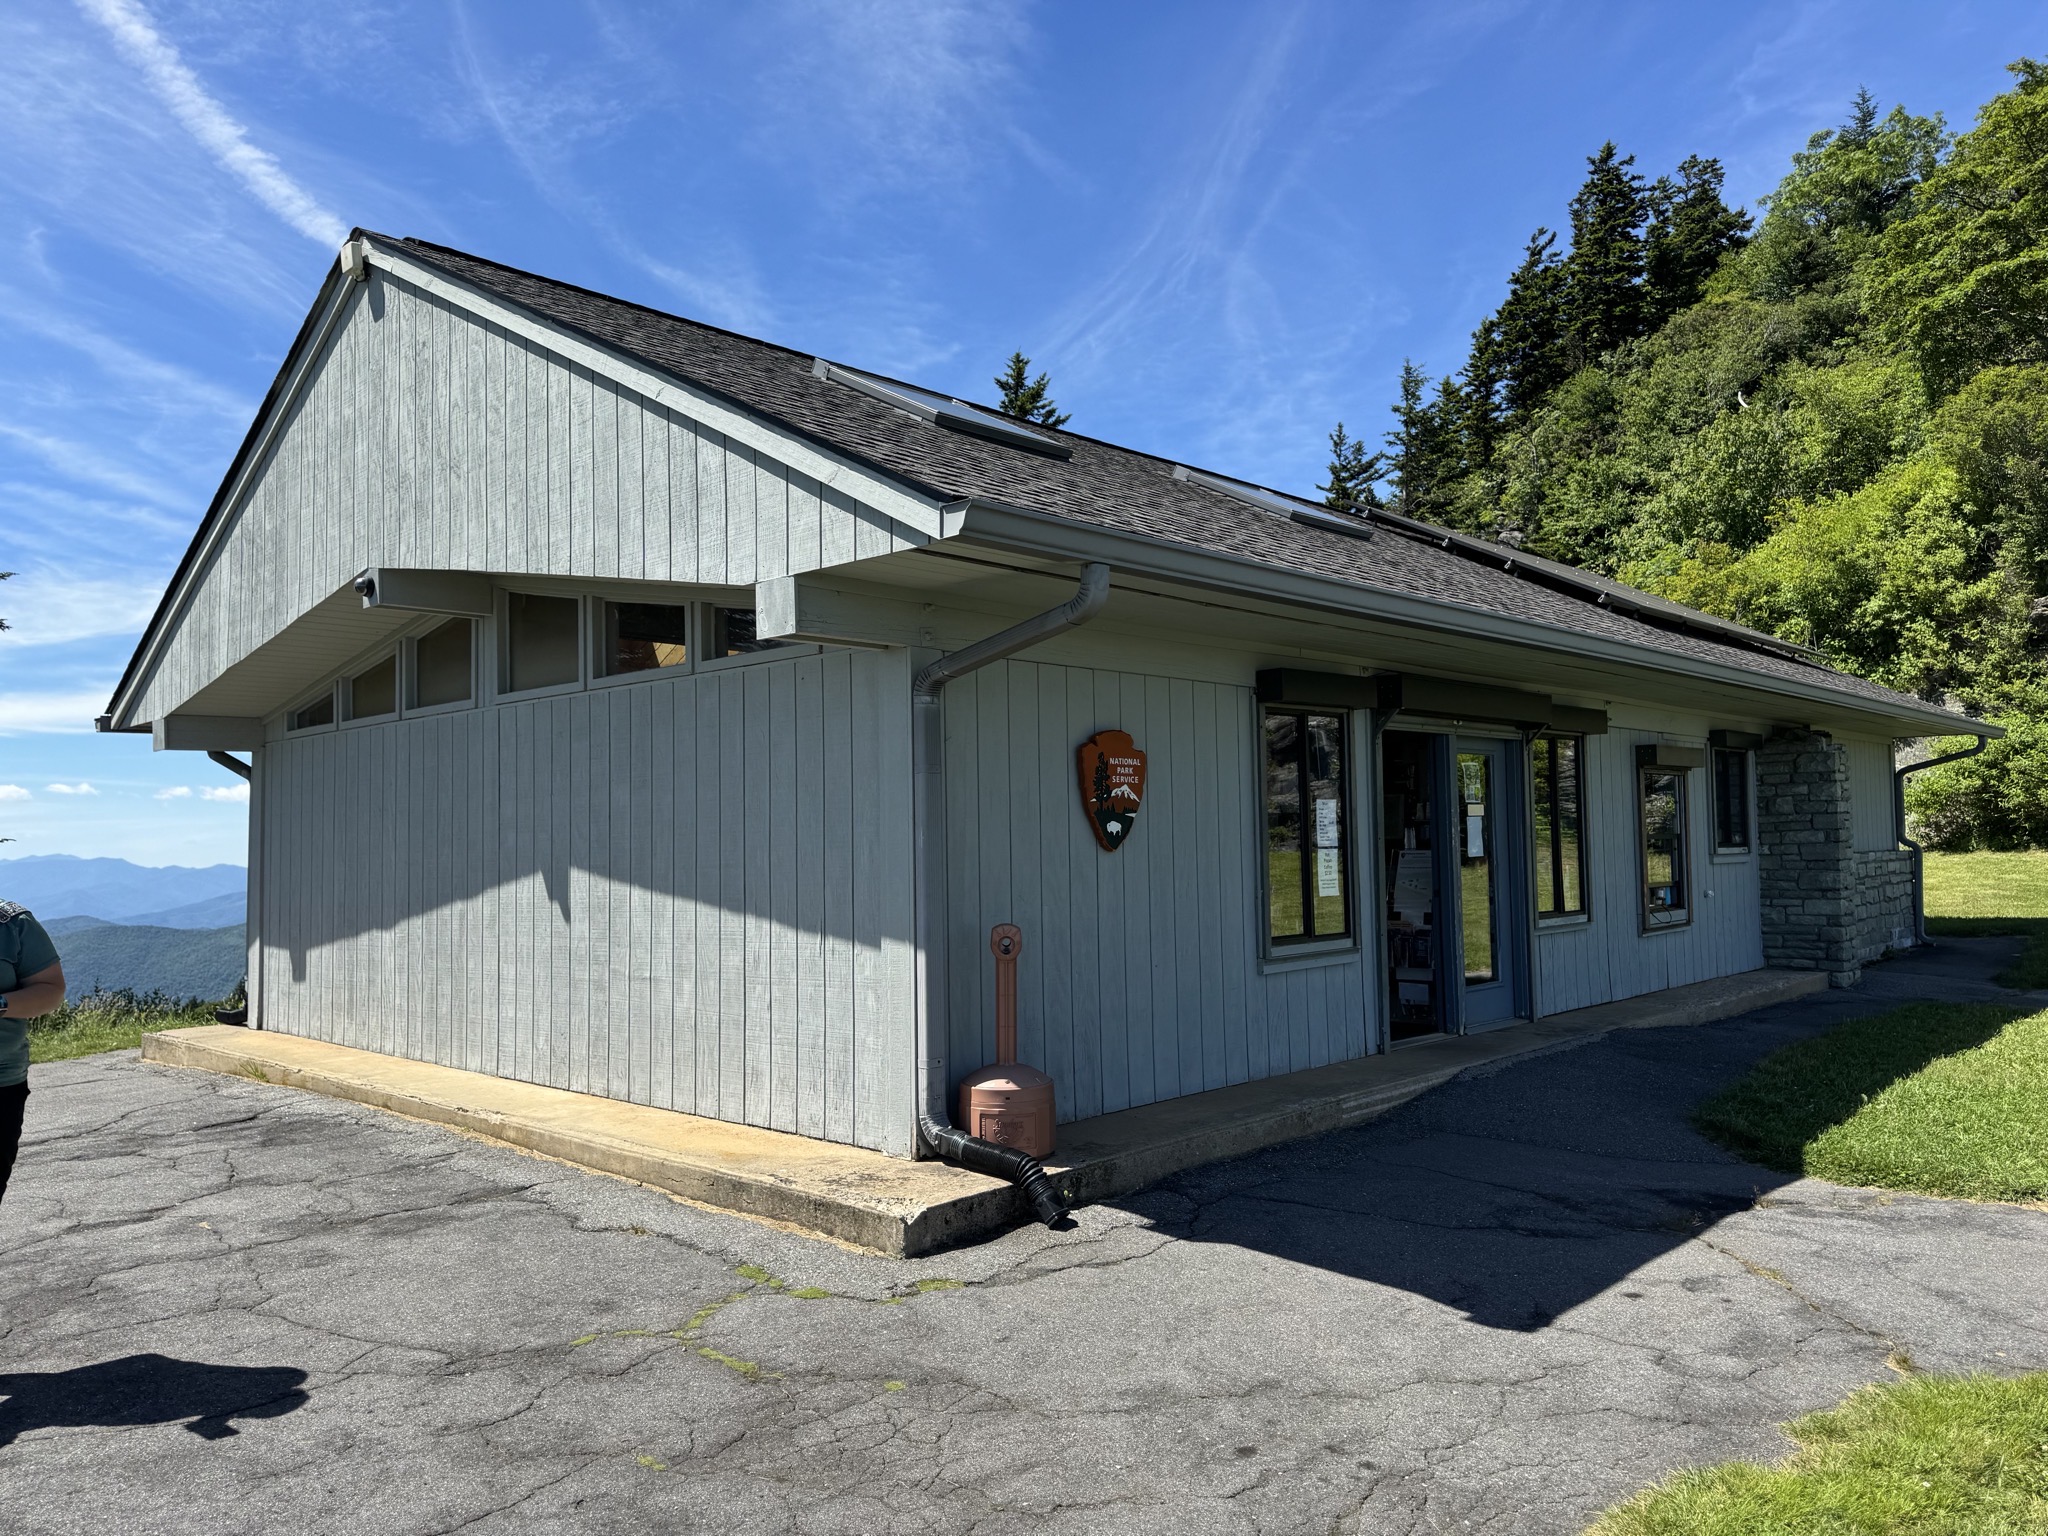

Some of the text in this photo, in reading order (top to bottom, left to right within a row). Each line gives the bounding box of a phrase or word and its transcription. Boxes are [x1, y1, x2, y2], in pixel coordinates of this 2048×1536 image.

[1109, 757, 1141, 766] NATIONAL
[1117, 766, 1133, 774] PARK
[1112, 775, 1139, 784] SERVICE
